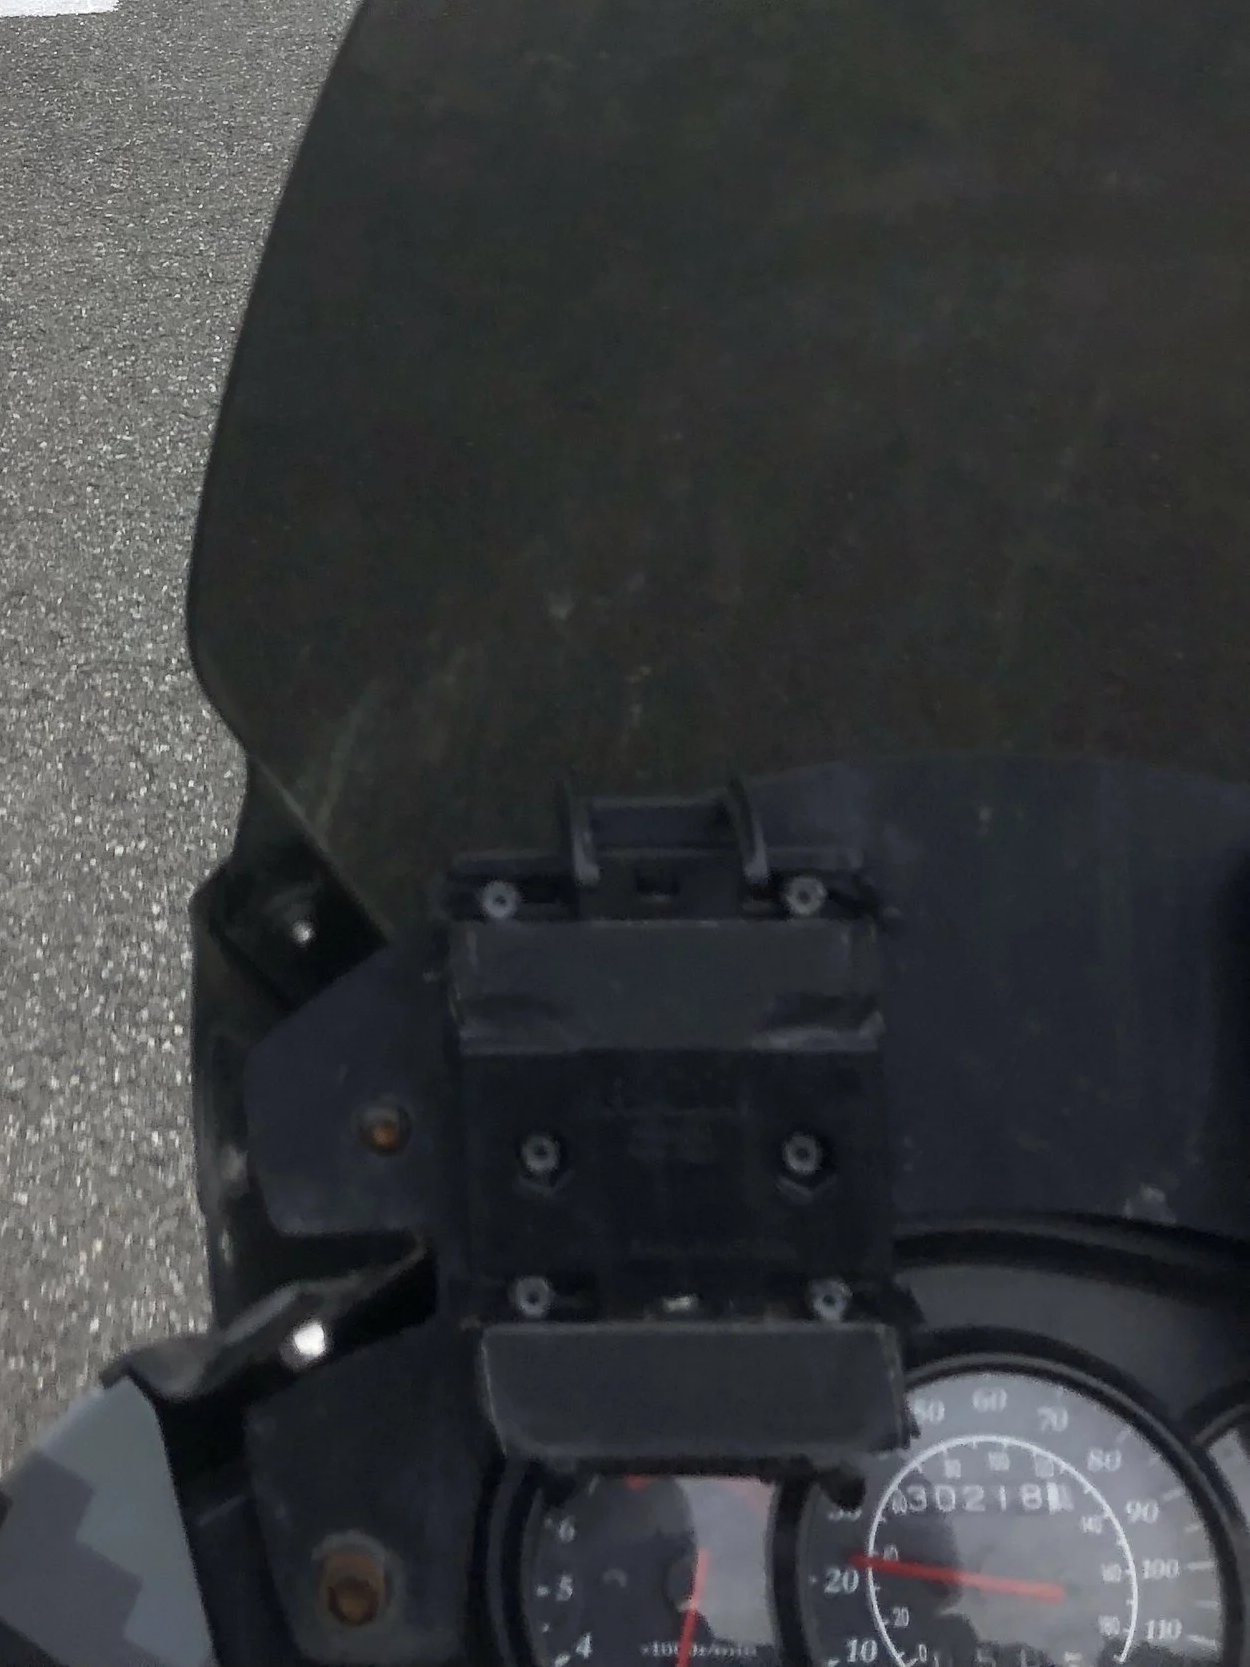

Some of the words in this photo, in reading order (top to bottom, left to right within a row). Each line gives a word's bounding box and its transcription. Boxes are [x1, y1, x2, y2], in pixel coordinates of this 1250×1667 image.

[824, 1567, 860, 1594] 20
[1142, 1558, 1180, 1579] 100
[1146, 1618, 1183, 1641] 110
[848, 1638, 878, 1664] 10
